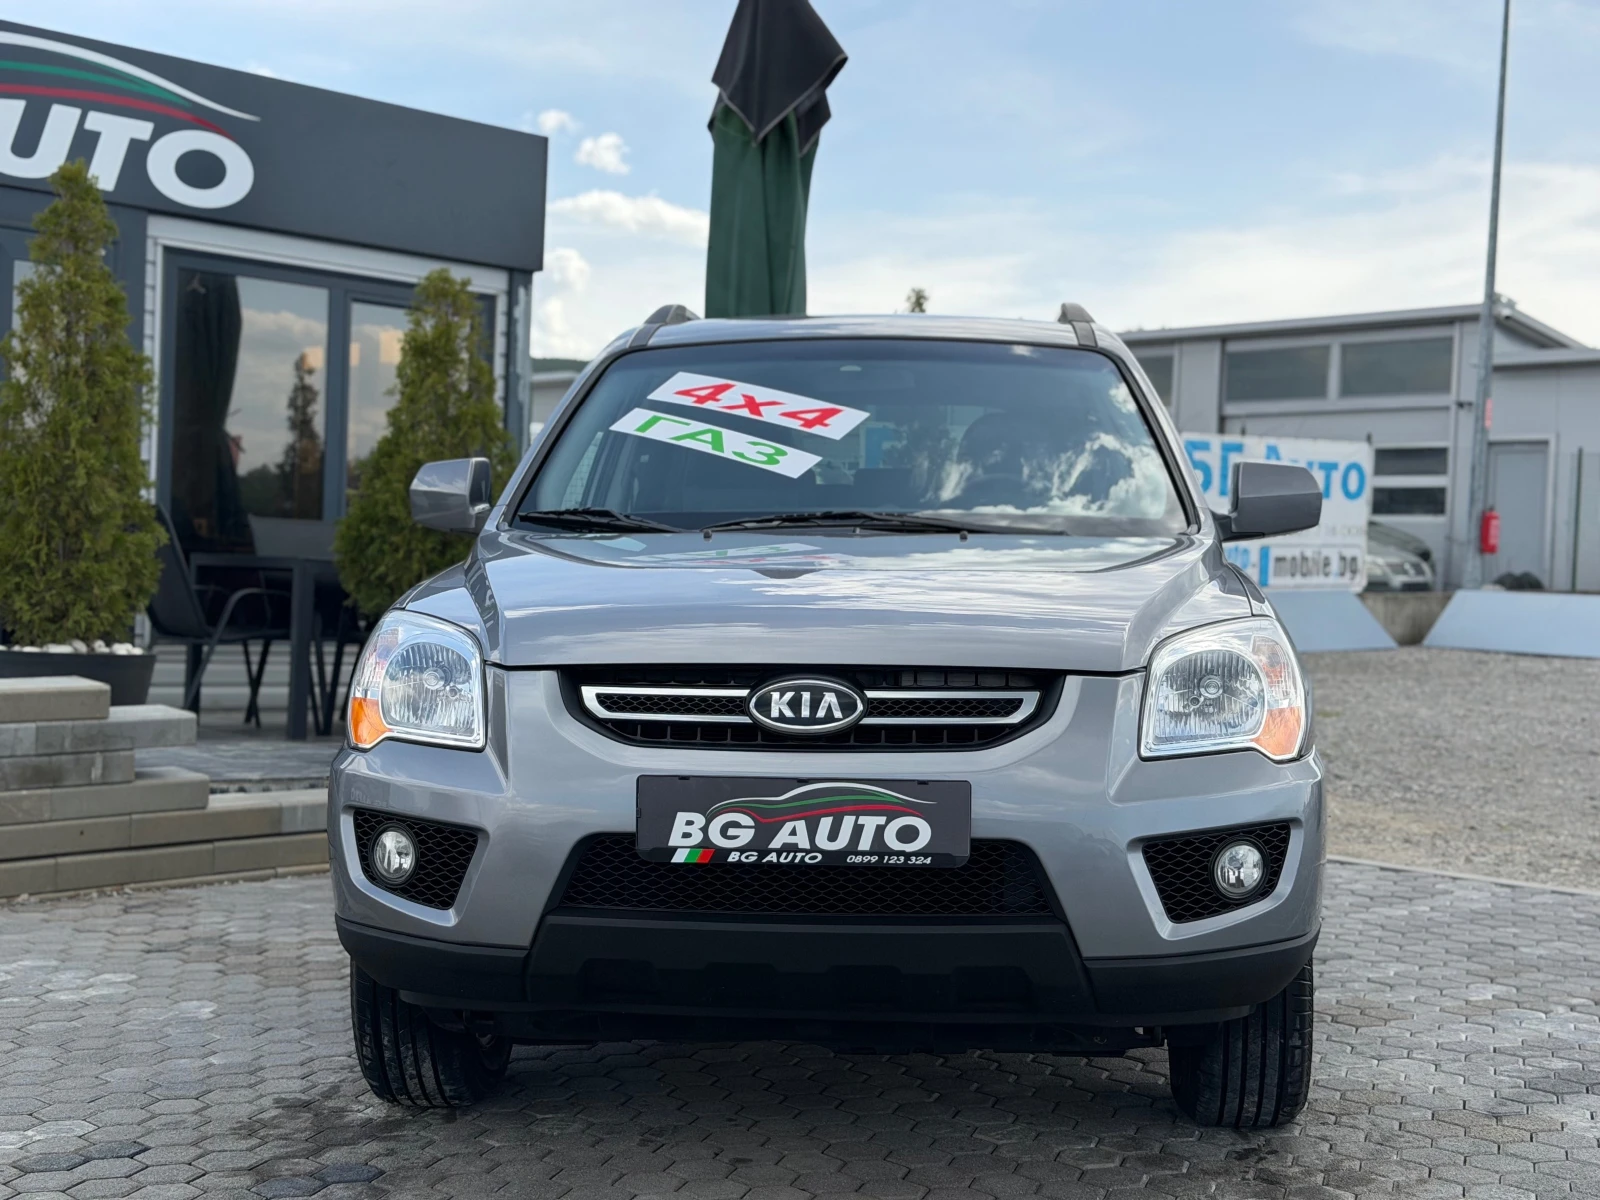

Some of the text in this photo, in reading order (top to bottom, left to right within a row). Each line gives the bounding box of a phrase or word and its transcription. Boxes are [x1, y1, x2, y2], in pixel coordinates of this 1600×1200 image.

[633, 415, 789, 466] ГАЗ
[770, 691, 843, 718] KIA
[668, 811, 932, 852] BG AUTO
[726, 851, 823, 864] BG AUTO
[846, 855, 932, 865] 0899 123 324
